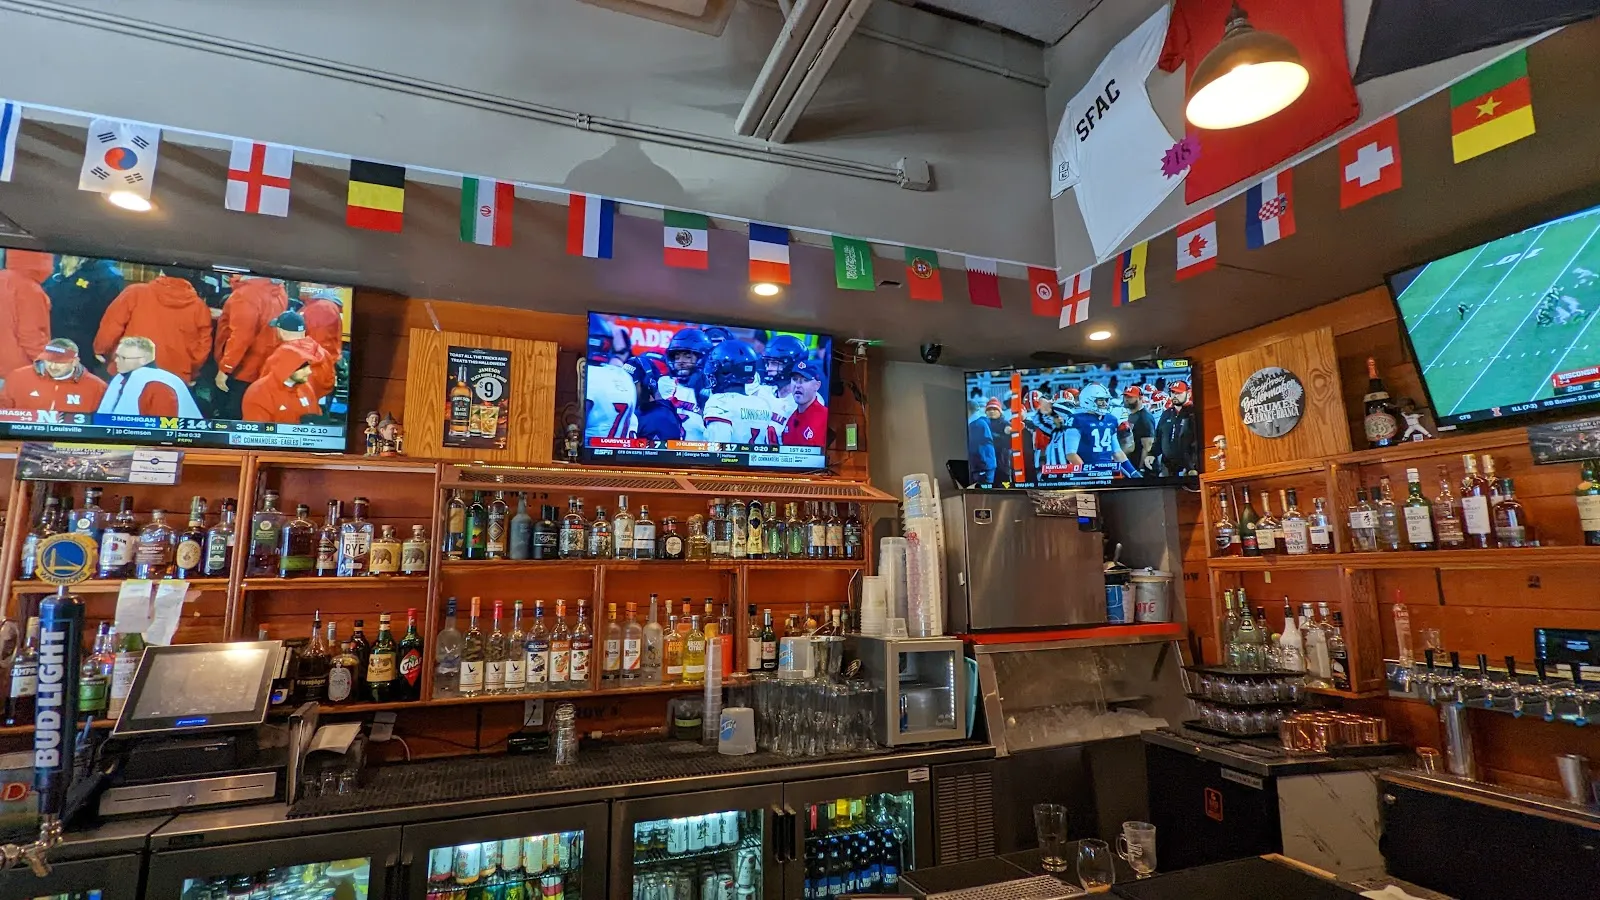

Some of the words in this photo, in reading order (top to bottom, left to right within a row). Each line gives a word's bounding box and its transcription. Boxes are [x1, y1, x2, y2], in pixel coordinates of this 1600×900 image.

[1076, 78, 1120, 142] SFAC
[1558, 368, 1599, 380] WISCONSIN
[479, 381, 494, 398] $9
[1566, 384, 1584, 392] 2ND
[66, 394, 81, 404] N
[1250, 399, 1300, 414] TRUMER
[36, 410, 58, 424] N
[74, 414, 86, 424] 3
[740, 408, 770, 421] CUNNINGHAM
[1244, 412, 1254, 424] &
[50, 425, 82, 433] Louisville
[160, 417, 178, 429] M
[187, 420, 207, 430] 14
[236, 423, 258, 432] 3:02
[244, 436, 278, 445] COMMANDERS
[1091, 428, 1112, 452] 14
[345, 544, 365, 554] RYE
[40, 570, 86, 584] WARRIORS
[37, 627, 66, 708] LIGHT
[36, 710, 62, 768] BUD
